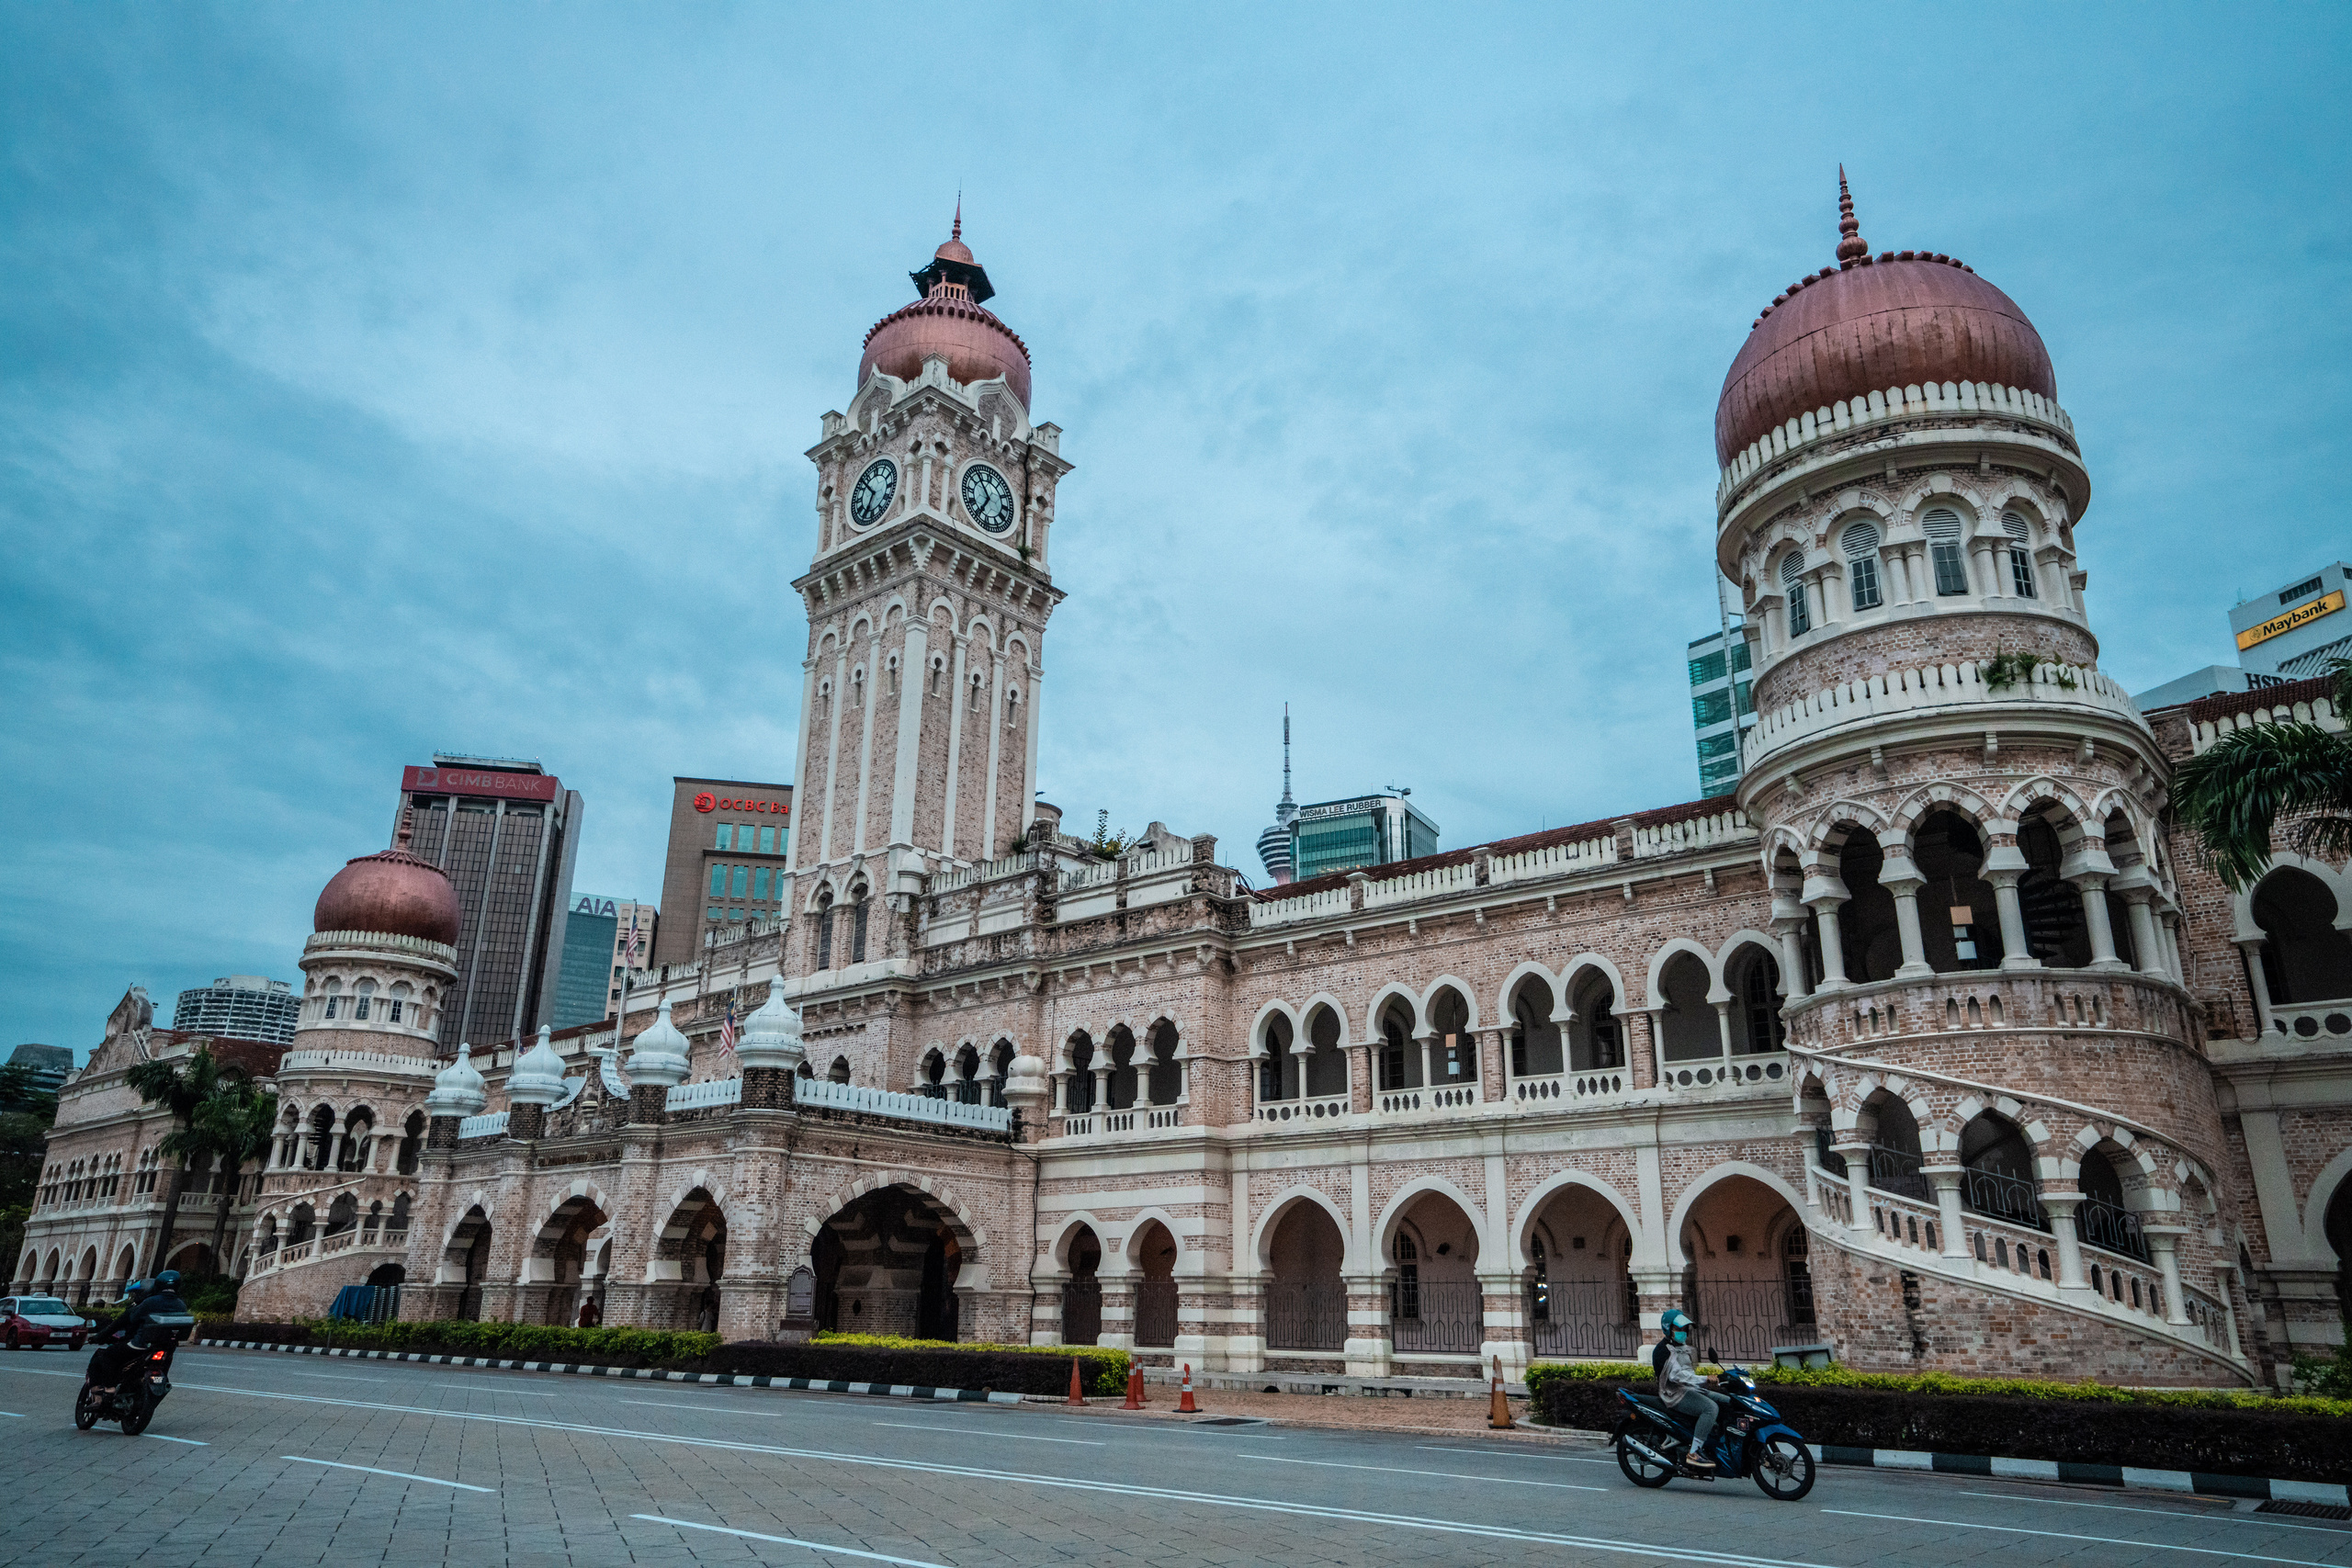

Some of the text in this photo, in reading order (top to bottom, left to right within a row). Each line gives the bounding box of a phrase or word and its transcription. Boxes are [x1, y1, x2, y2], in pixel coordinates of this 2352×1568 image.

[2263, 601, 2328, 636] Maybank
[447, 773, 540, 792] CIMB BANK
[719, 797, 788, 814] OCBC Ba
[1299, 799, 1382, 818] WISMA LEE RUBBER
[576, 897, 616, 916] AIA
